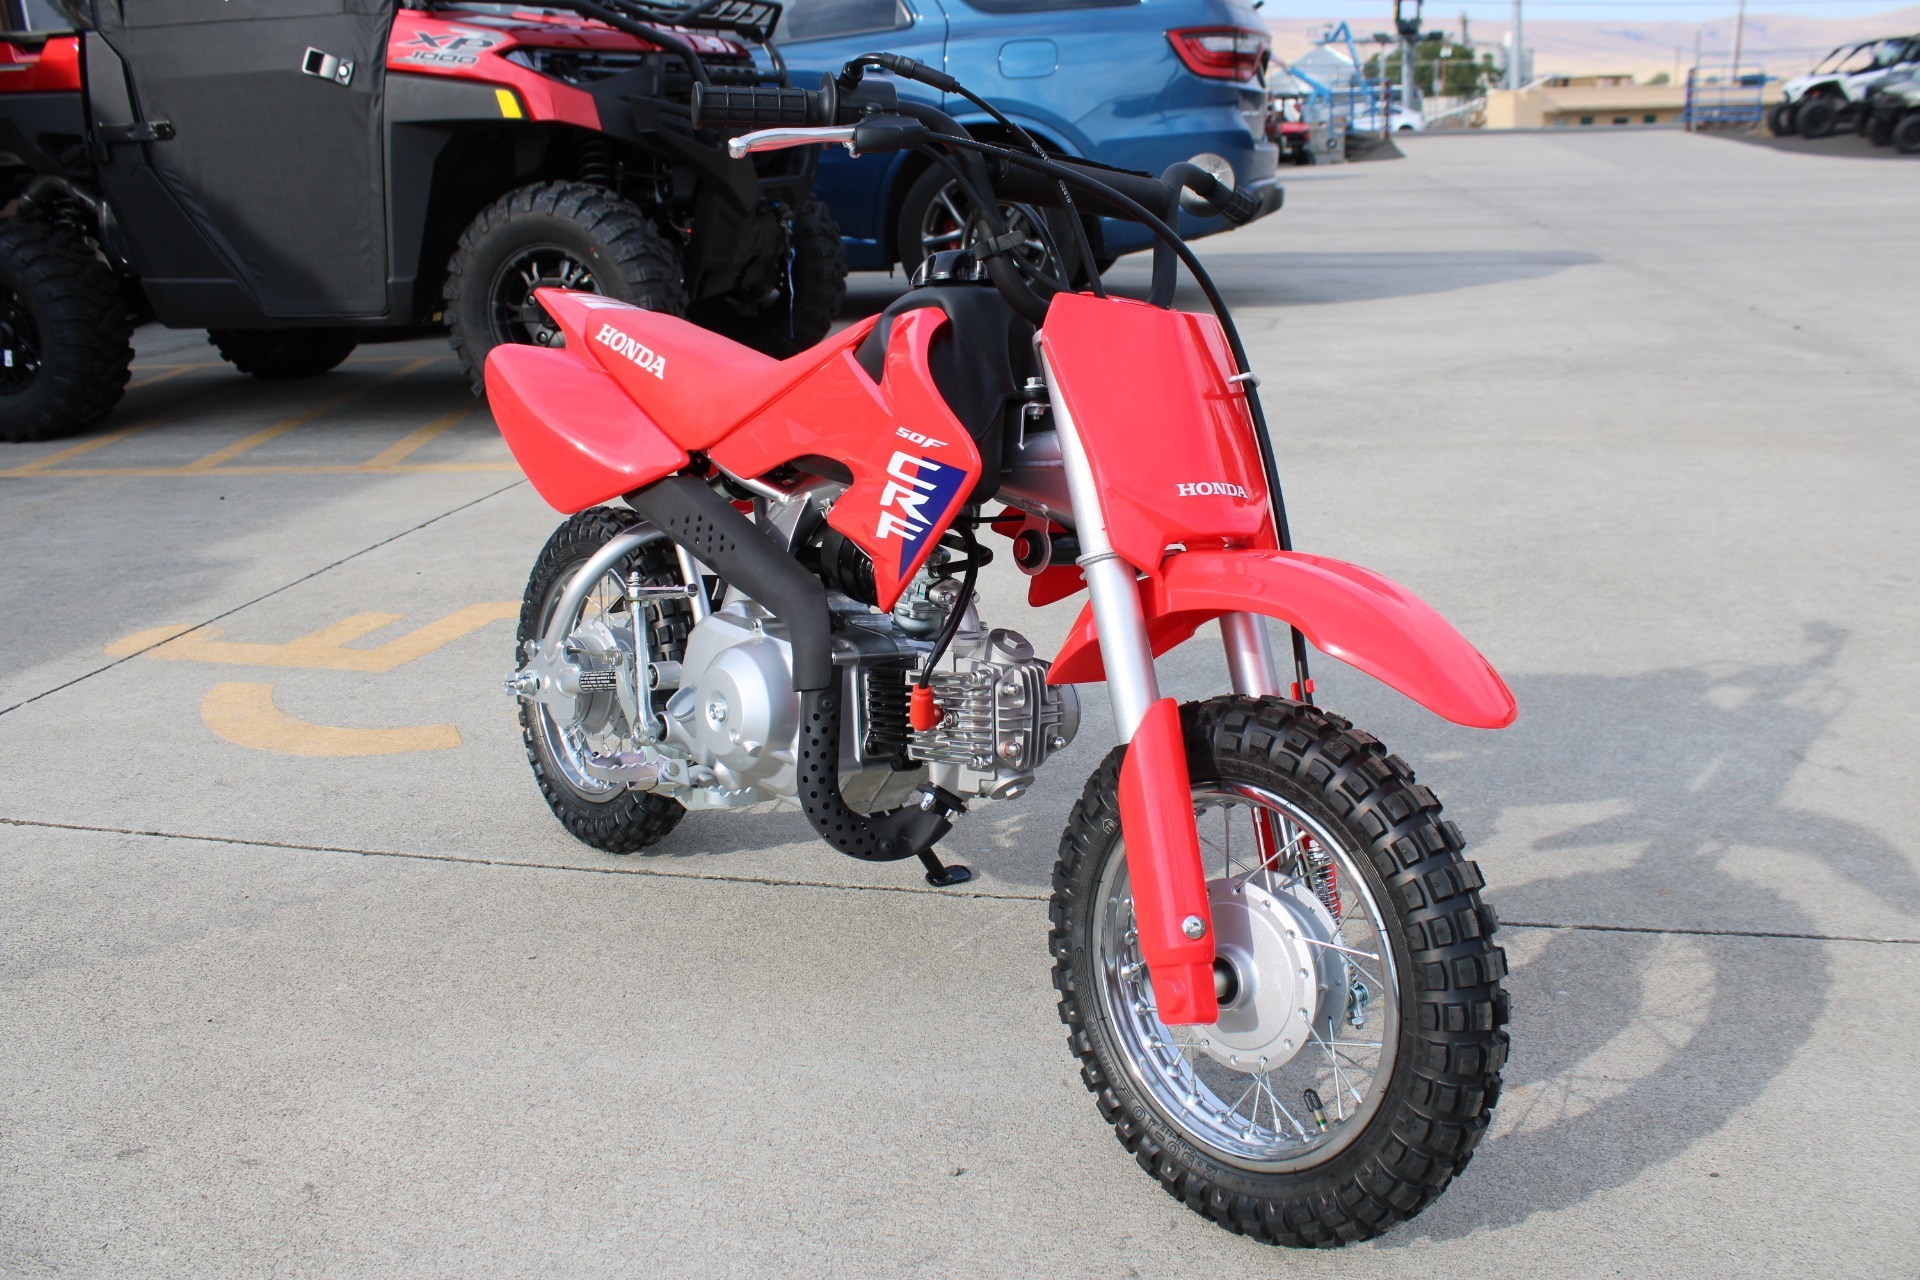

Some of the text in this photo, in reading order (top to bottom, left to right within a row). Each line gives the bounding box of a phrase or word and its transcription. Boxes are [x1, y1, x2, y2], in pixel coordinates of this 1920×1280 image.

[401, 31, 496, 50] XP
[413, 51, 478, 64] 1000
[595, 323, 667, 380] HONDA
[895, 426, 949, 448] 50F
[875, 450, 942, 541] CRF
[1176, 482, 1249, 499] HONDA
